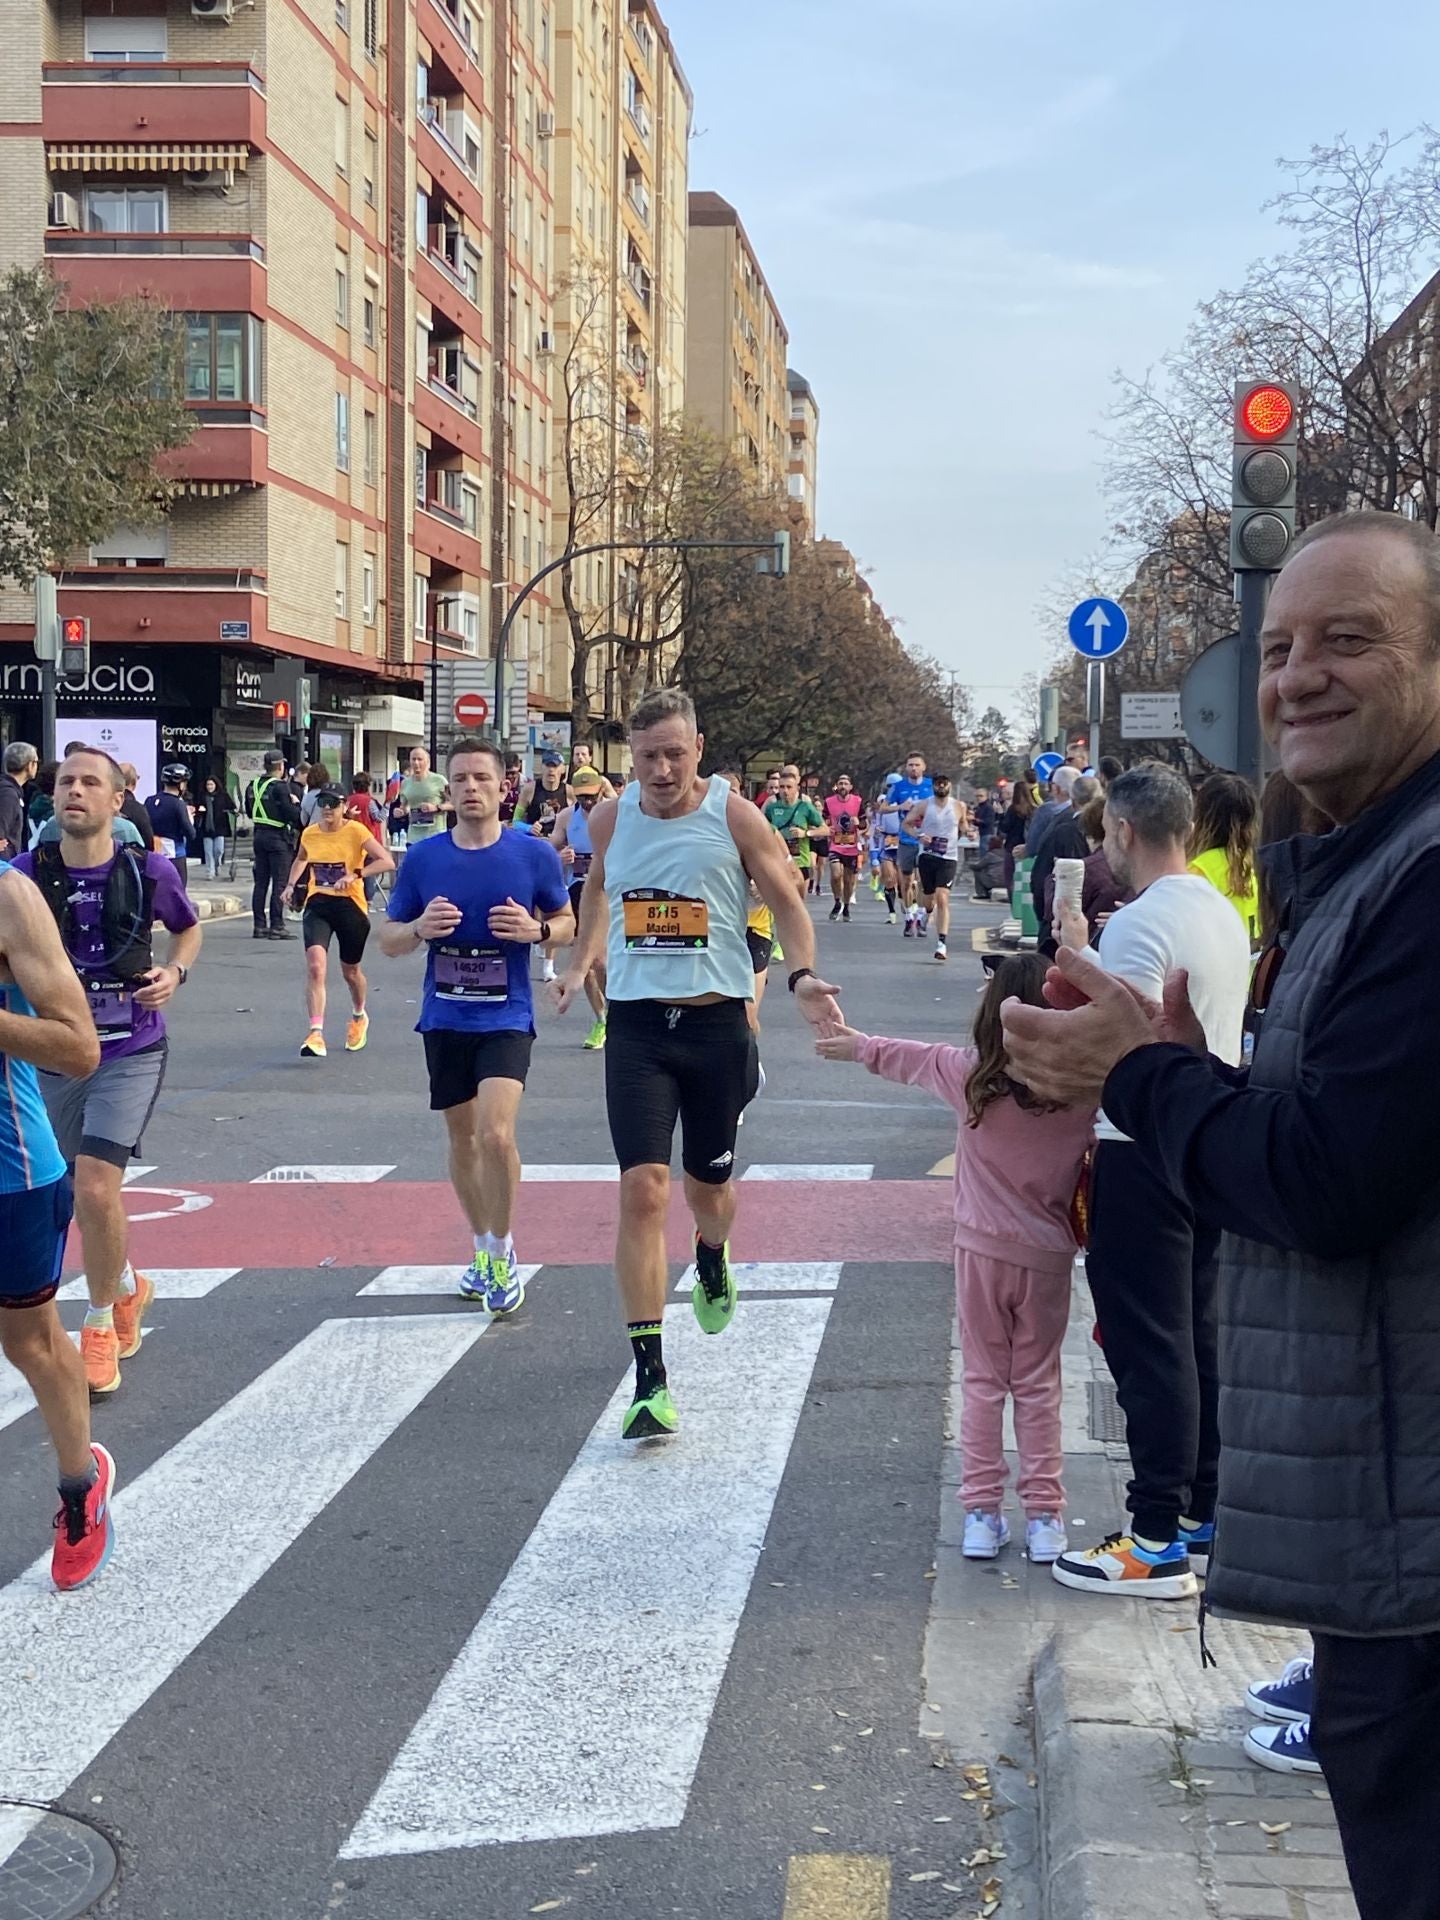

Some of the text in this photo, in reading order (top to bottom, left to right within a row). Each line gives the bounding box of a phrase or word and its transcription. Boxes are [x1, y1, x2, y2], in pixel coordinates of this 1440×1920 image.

[162, 725, 208, 736] farmacia
[163, 740, 206, 753] 12 horas
[646, 923, 680, 935] Maciej
